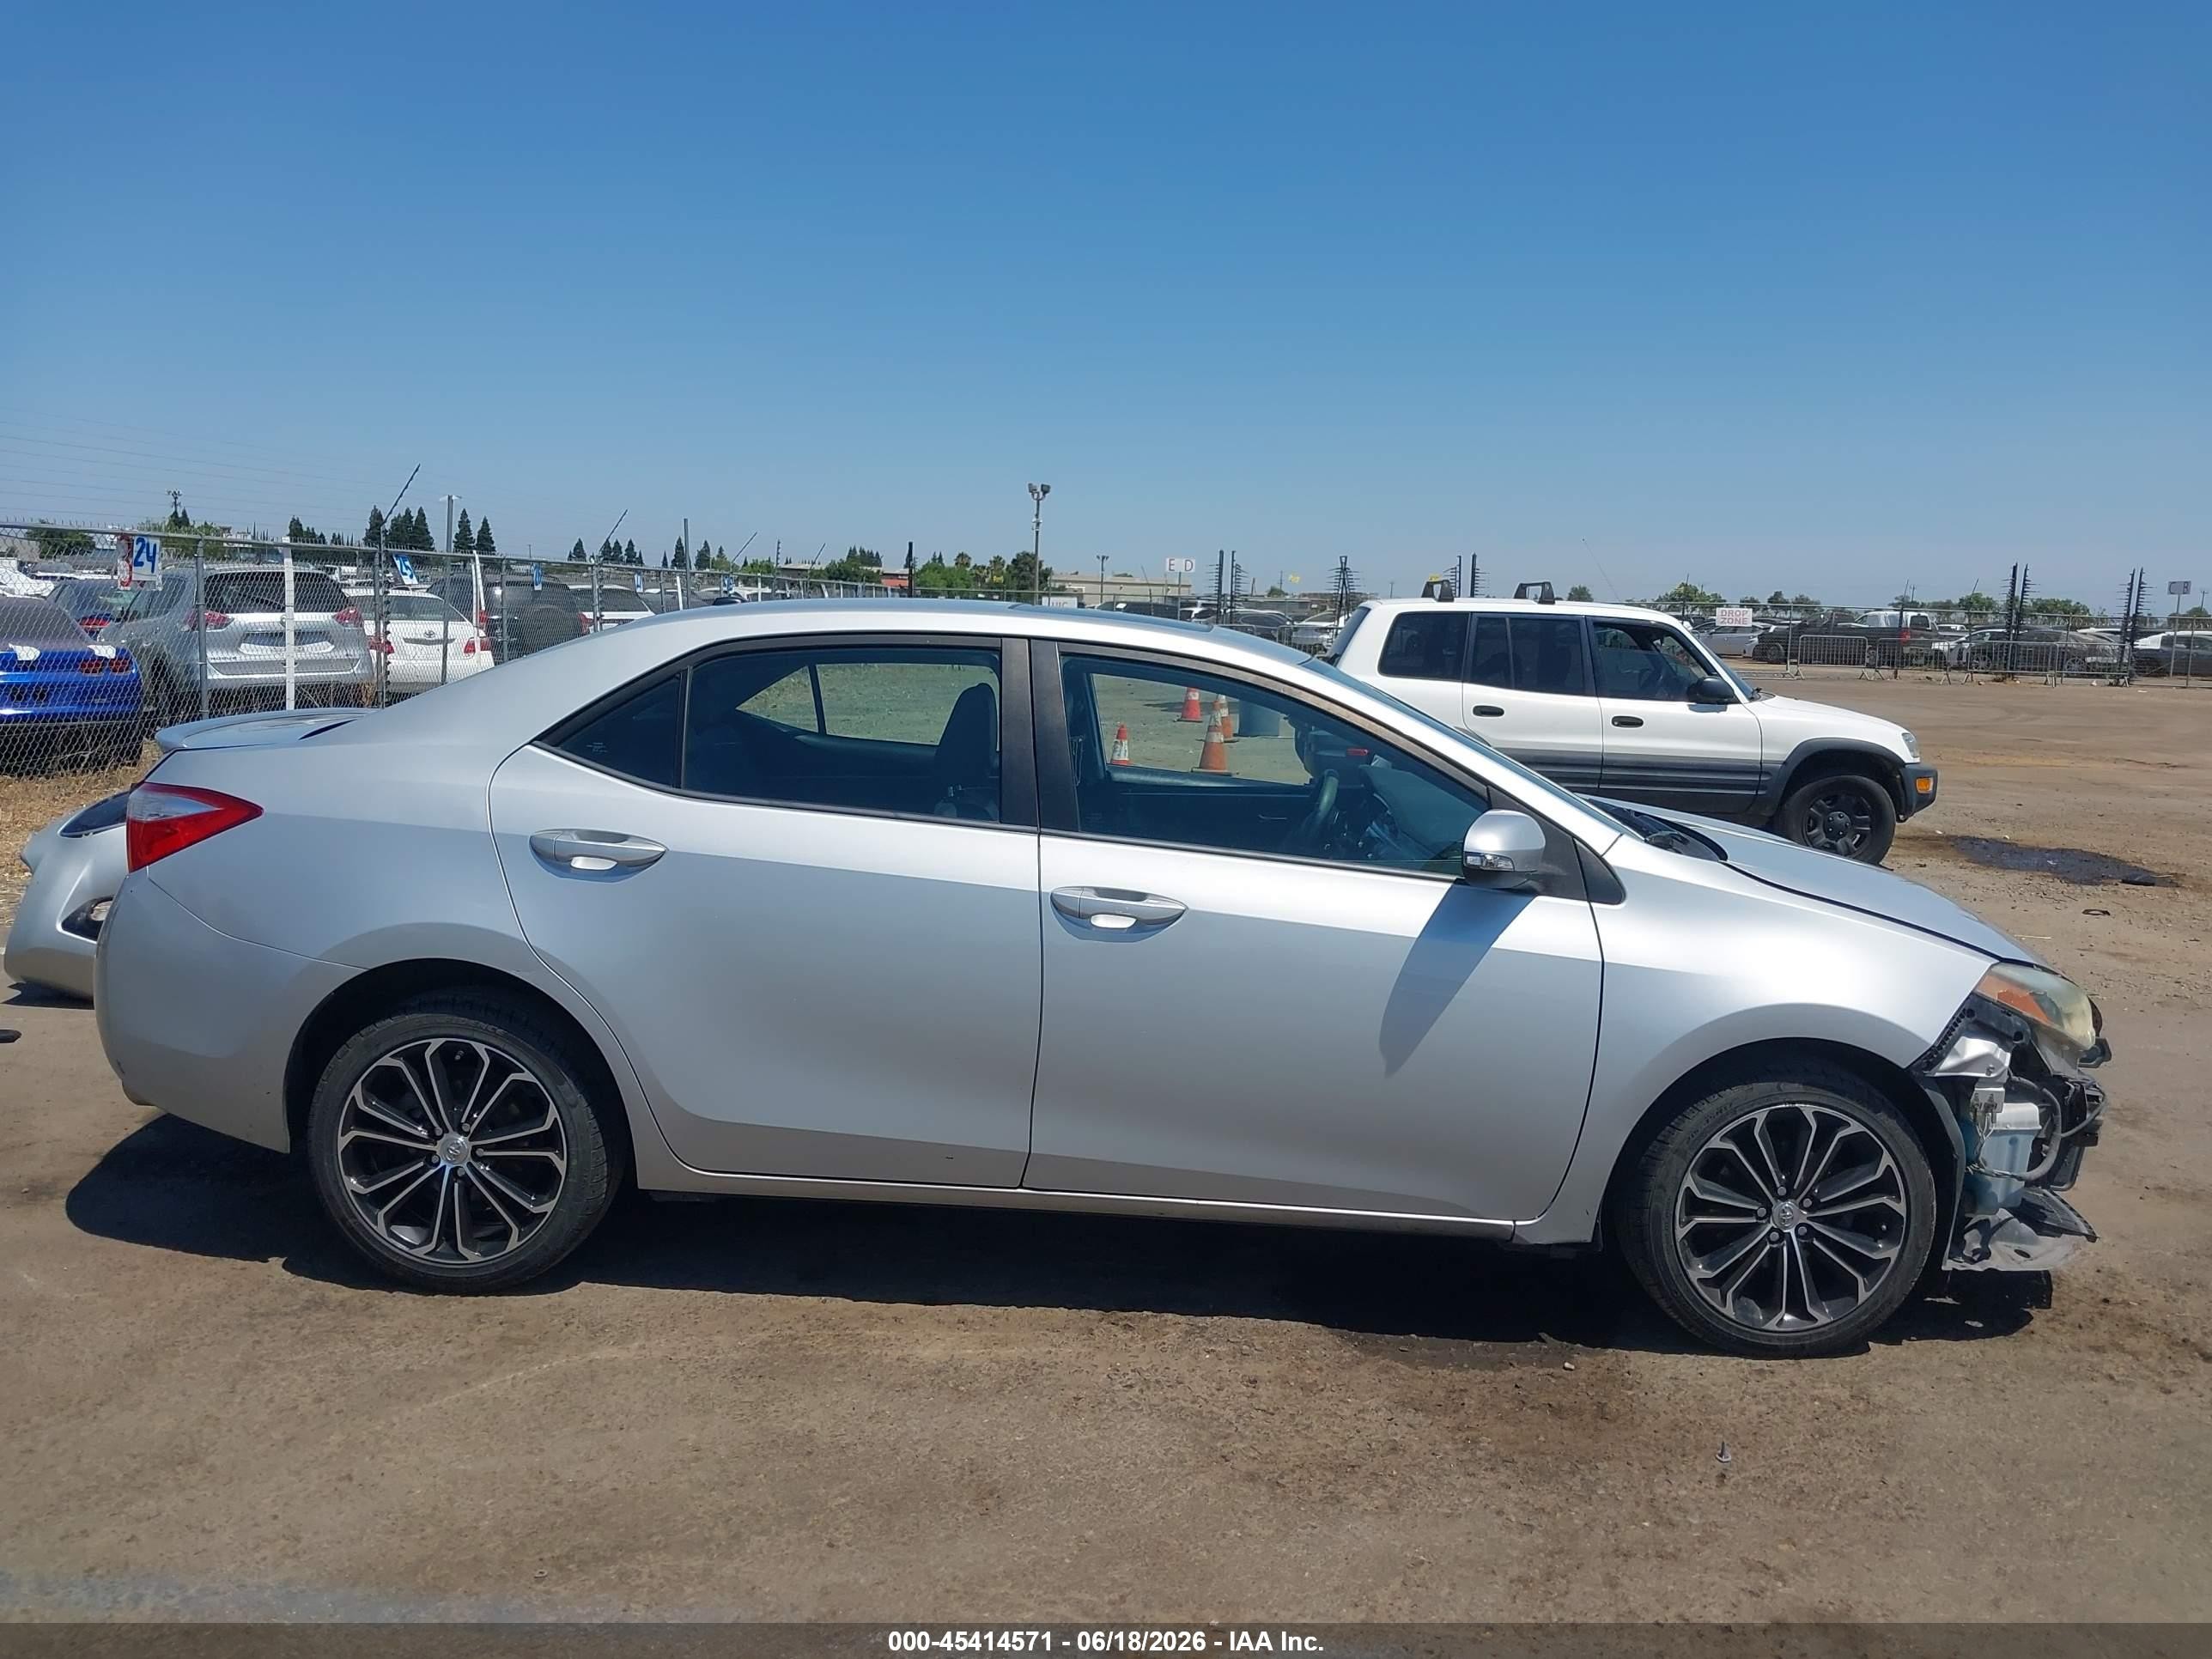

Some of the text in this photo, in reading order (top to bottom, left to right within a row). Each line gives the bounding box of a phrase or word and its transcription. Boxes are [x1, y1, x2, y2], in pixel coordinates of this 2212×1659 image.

[134, 537, 156, 574] 24
[395, 555, 414, 579] 25
[1169, 558, 1194, 572] E D
